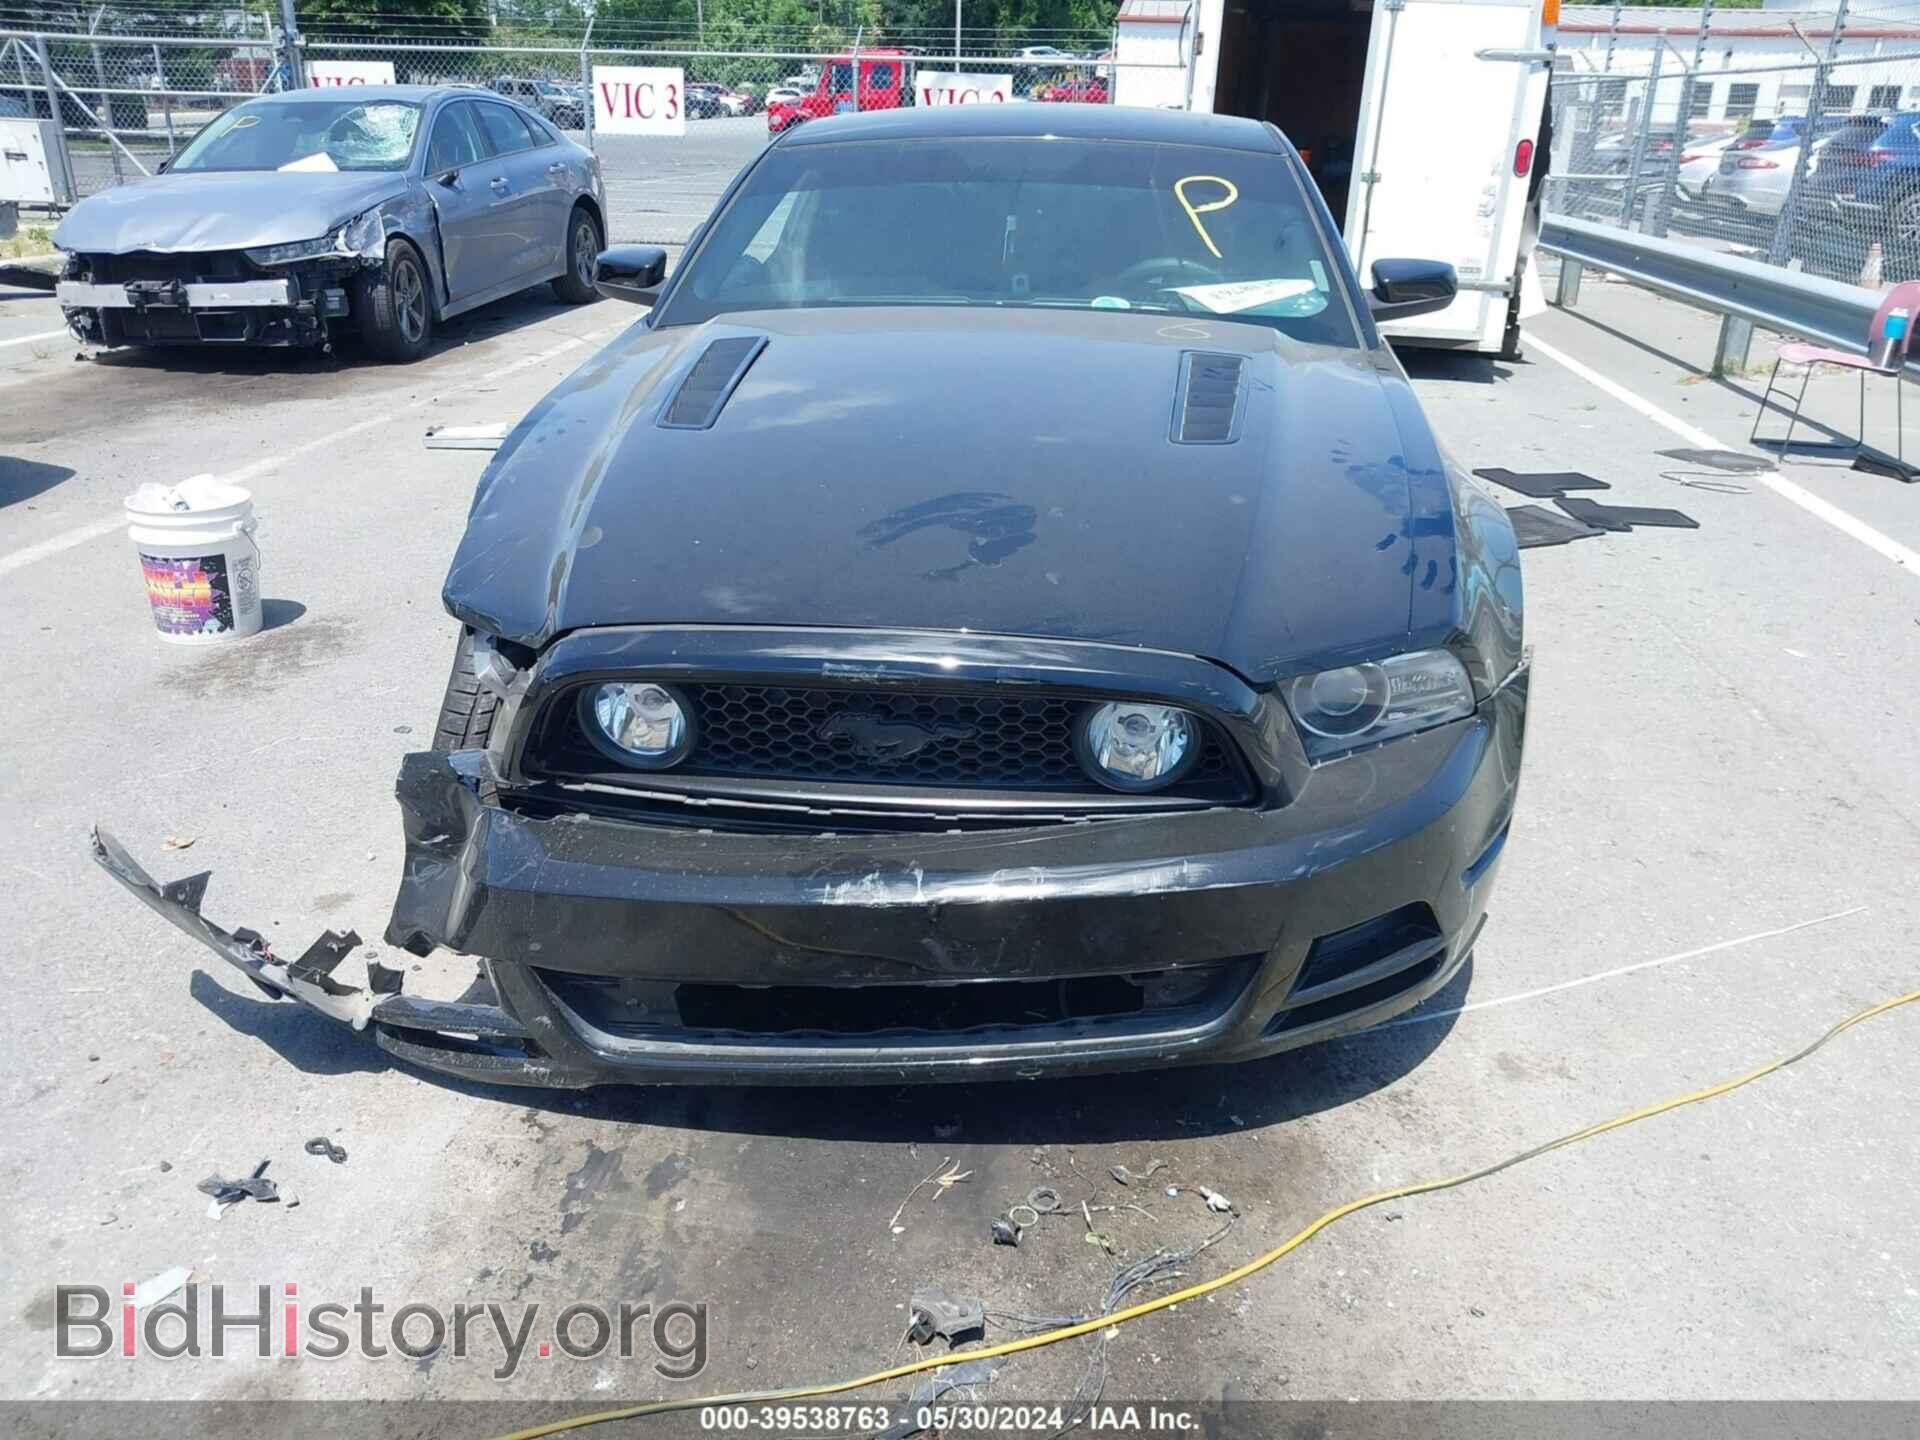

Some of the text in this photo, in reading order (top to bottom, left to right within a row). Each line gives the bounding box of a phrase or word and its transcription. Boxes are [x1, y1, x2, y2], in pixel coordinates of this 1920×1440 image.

[600, 82, 678, 119] VIC 3
[1174, 175, 1238, 258] P
